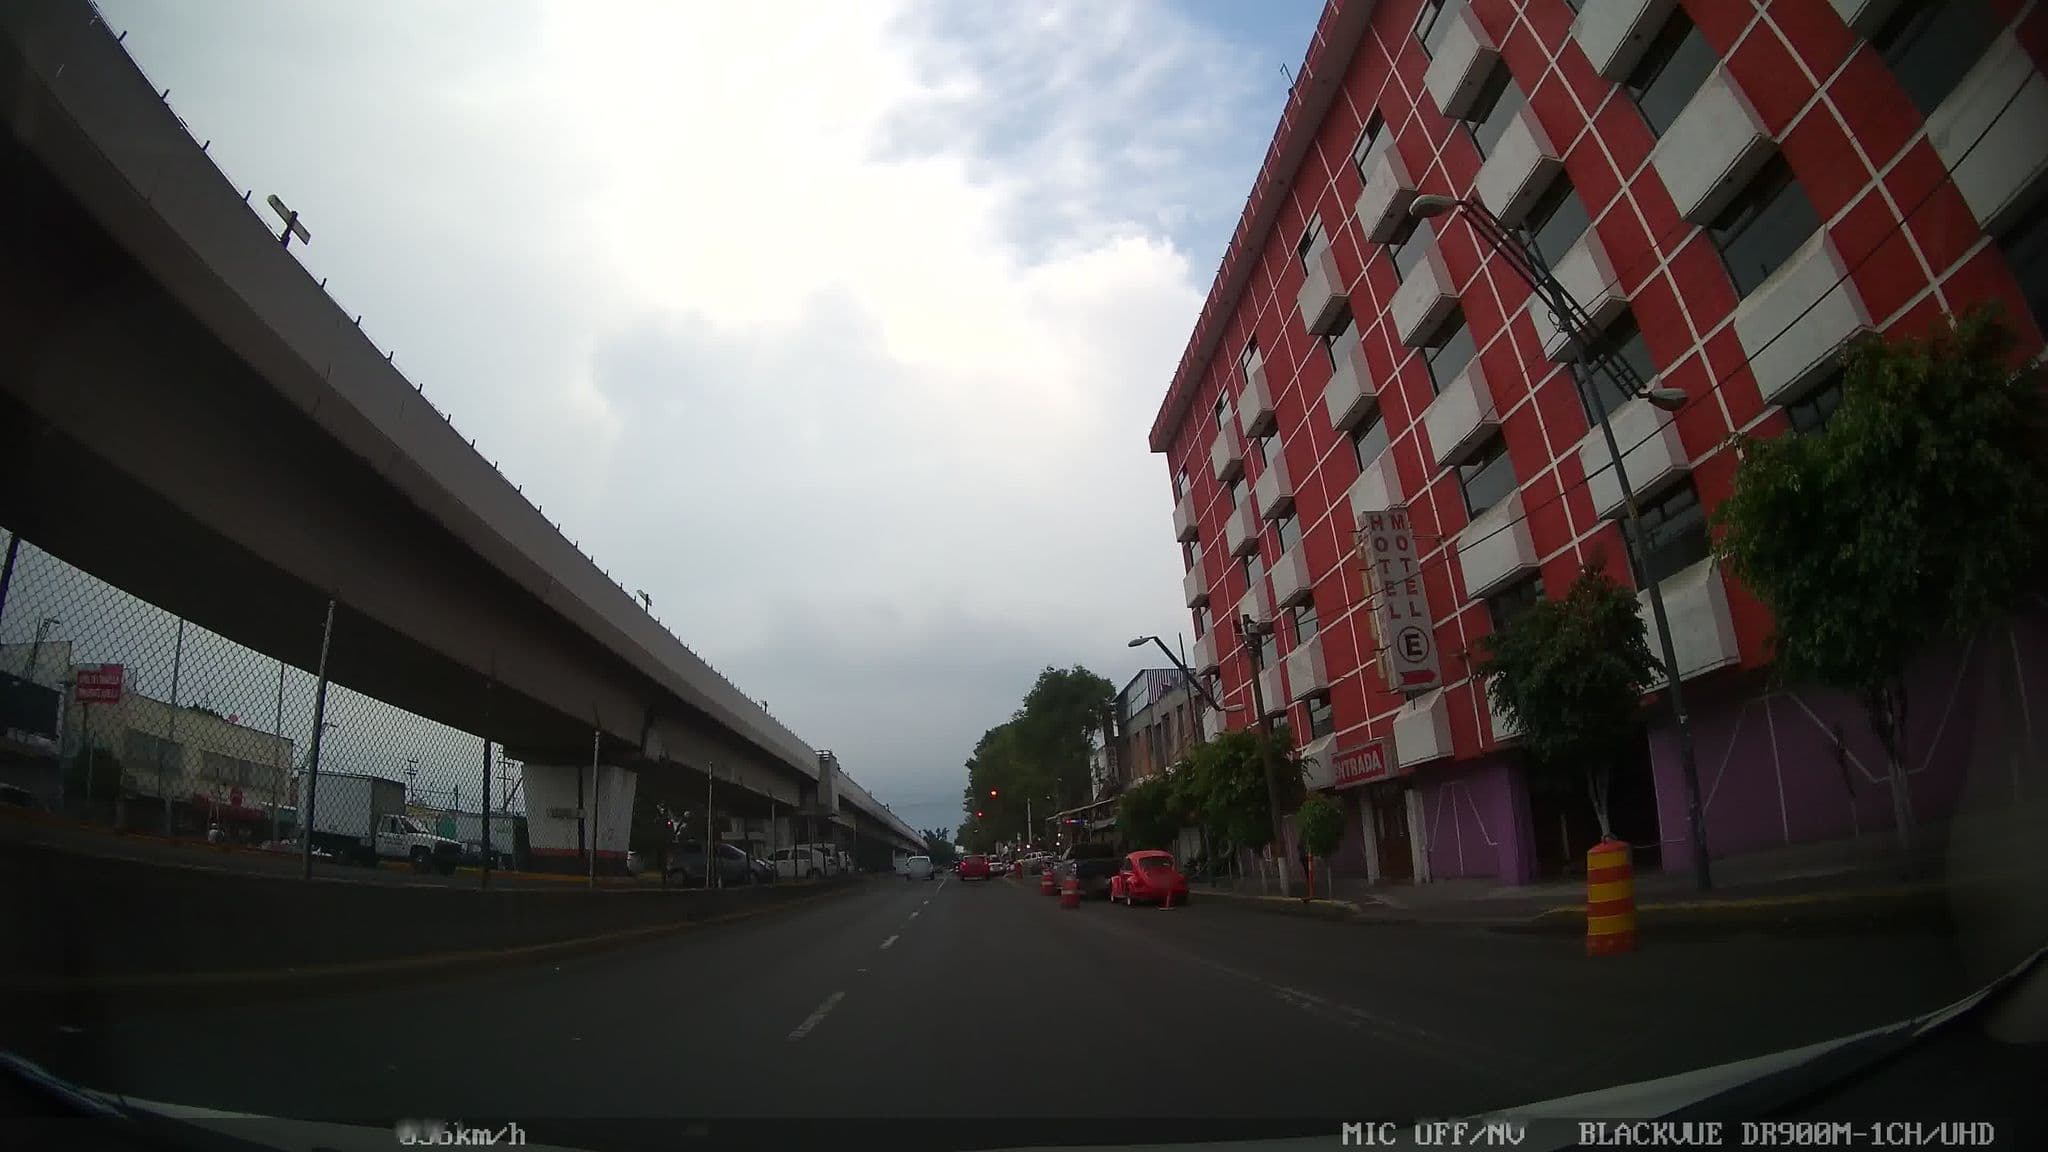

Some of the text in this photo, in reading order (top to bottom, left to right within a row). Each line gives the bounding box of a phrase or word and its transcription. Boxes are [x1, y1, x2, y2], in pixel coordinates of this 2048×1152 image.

[1371, 514, 1401, 620] HOTEL
[1391, 513, 1422, 618] MOTEL
[1405, 633, 1422, 657] E
